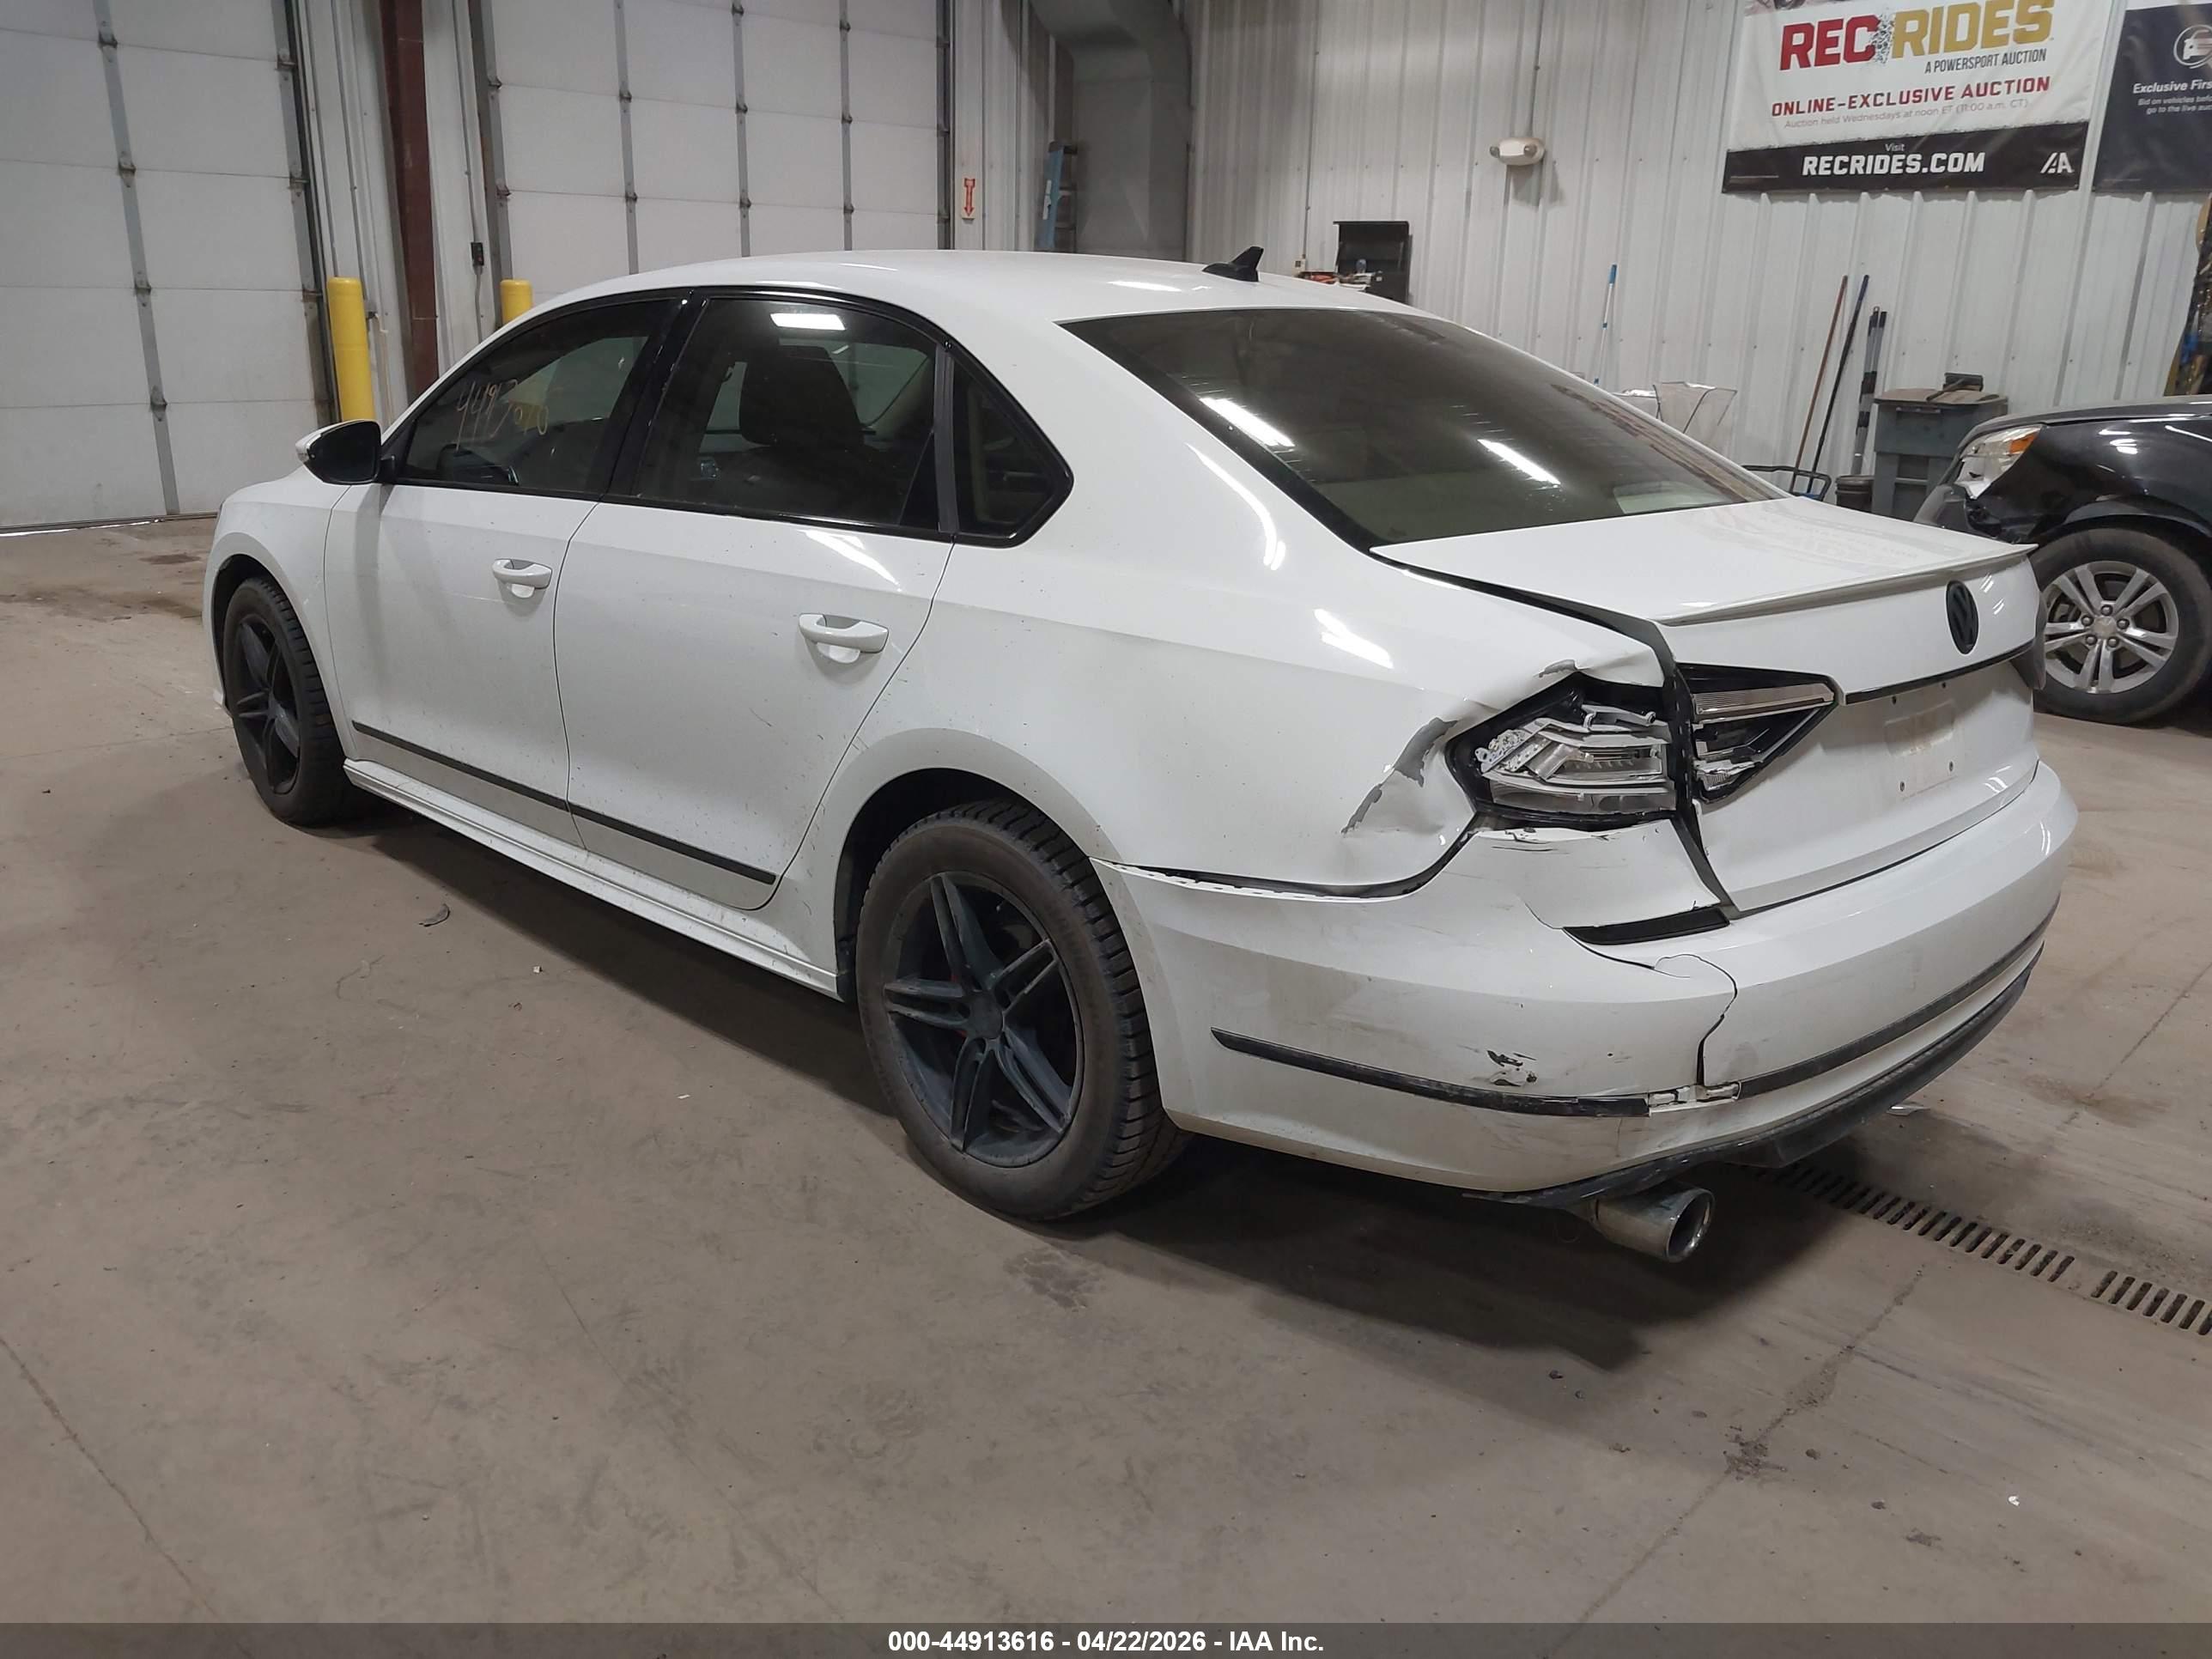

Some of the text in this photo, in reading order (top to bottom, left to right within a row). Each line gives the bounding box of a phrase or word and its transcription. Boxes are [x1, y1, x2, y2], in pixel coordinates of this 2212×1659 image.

[1780, 0, 2055, 70] REC RIDES
[1924, 48, 2047, 74] A POWERSPORT AUCTION
[1771, 76, 2051, 117] ONLINE-EXCLUSIVE AUCTION
[2133, 81, 2189, 94] Exclusive
[1784, 118, 1819, 128] Auction
[1820, 114, 1841, 125] held
[1842, 110, 1901, 124] Wednesdays
[1903, 110, 1913, 118] at
[1915, 108, 1939, 117] noon
[1942, 105, 1954, 114] ET
[1885, 143, 1905, 152] Visit
[1802, 152, 1986, 176] RECRIDES.COM
